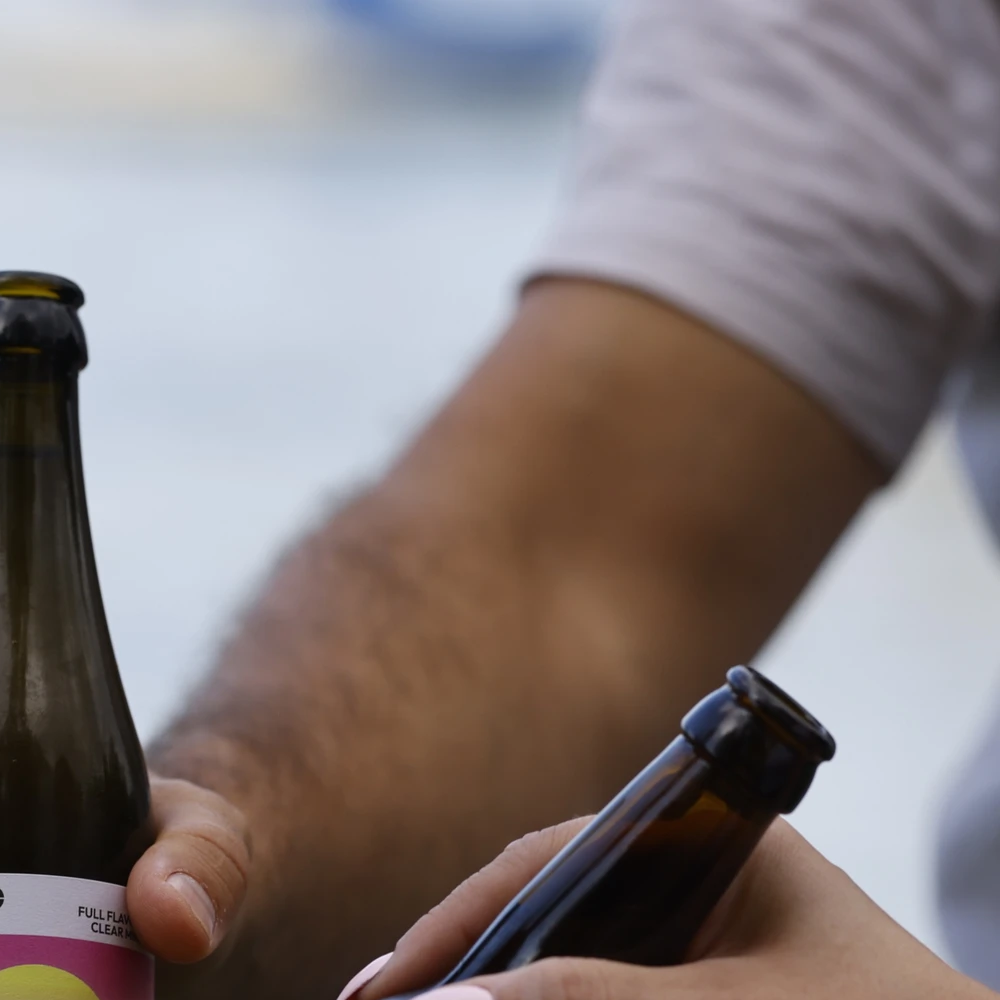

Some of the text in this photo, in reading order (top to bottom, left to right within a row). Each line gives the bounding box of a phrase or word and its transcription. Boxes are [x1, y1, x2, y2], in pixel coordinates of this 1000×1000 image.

[78, 905, 131, 926] FULL FLAV
[90, 921, 124, 939] CLEAR
